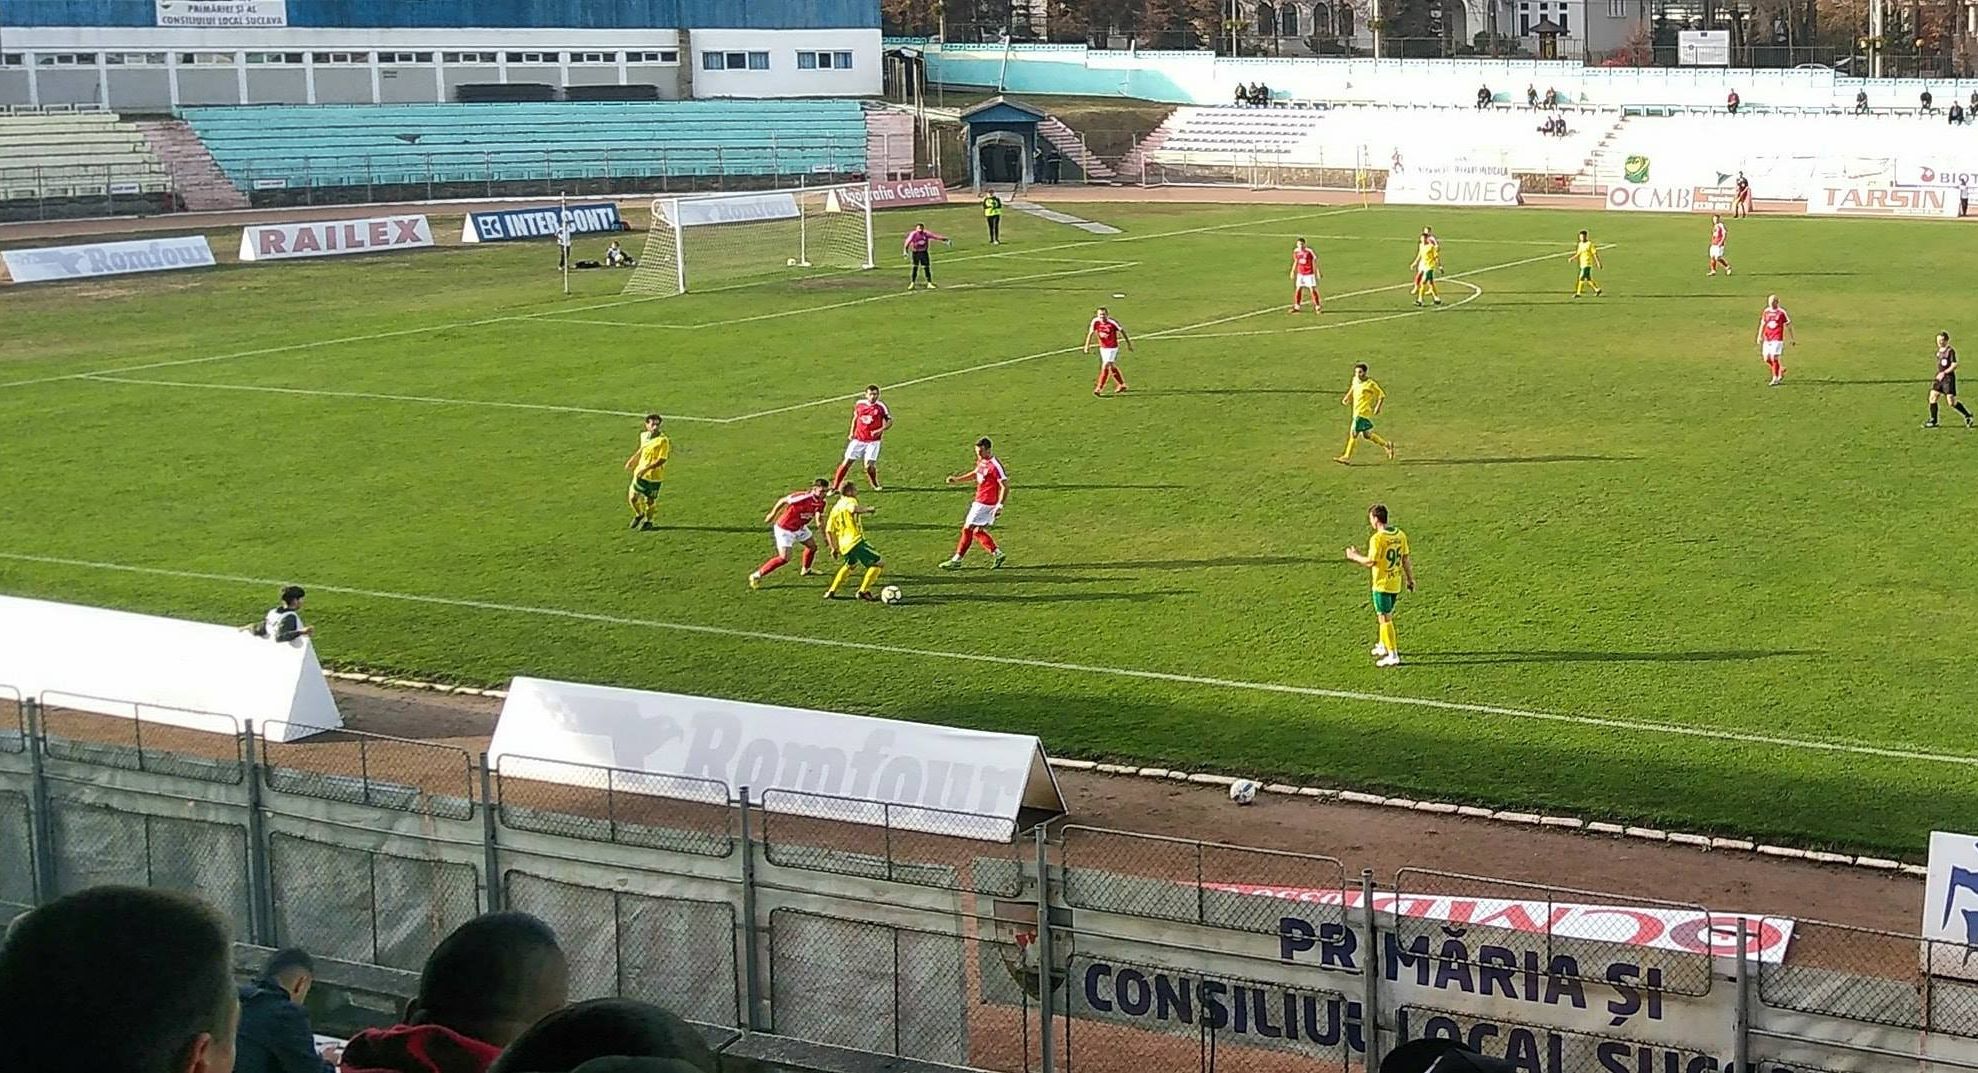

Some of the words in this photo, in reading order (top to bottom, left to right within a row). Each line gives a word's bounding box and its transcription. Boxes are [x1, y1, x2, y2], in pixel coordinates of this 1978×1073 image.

[162, 16, 216, 25] CONSILIULUI
[218, 16, 243, 25] LOCAL
[246, 16, 283, 25] SUCEAVA
[897, 182, 940, 199] Celestin
[1428, 180, 1516, 202] SUMEC
[1609, 186, 1690, 209] OCMB
[1823, 187, 1946, 208] TARSIN
[504, 211, 560, 237] INTER
[258, 218, 423, 255] RAILEX
[83, 241, 211, 273] Romfour
[681, 710, 1025, 818] Romfour
[1279, 916, 1588, 1009] PRMĂRIA
